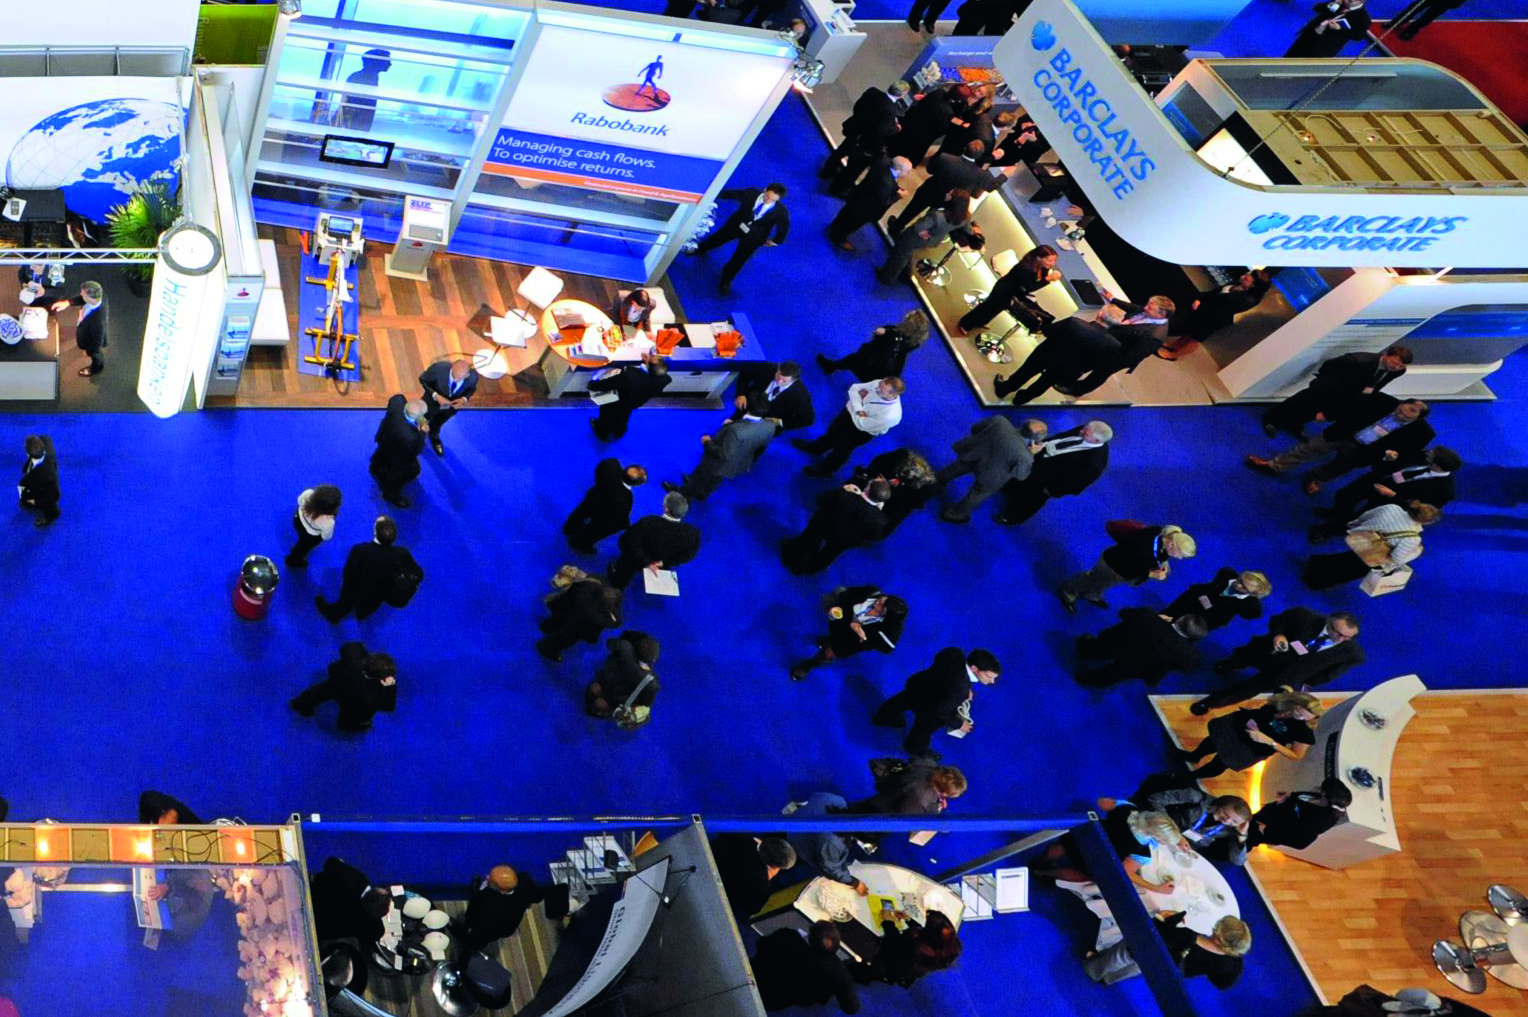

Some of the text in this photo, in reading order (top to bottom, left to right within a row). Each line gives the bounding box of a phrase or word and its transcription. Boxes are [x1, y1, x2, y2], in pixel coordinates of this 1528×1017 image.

[570, 111, 671, 137] Rabobank
[1050, 47, 1158, 182] BARCLAYS
[1033, 69, 1134, 200] CORPORATE
[492, 147, 636, 179] To optimise returns.
[496, 134, 656, 169] Managing cash flows.
[1285, 215, 1470, 234] BARCLAYS
[1262, 235, 1440, 252] CORPORATE
[148, 277, 188, 406] Handelsbanken
